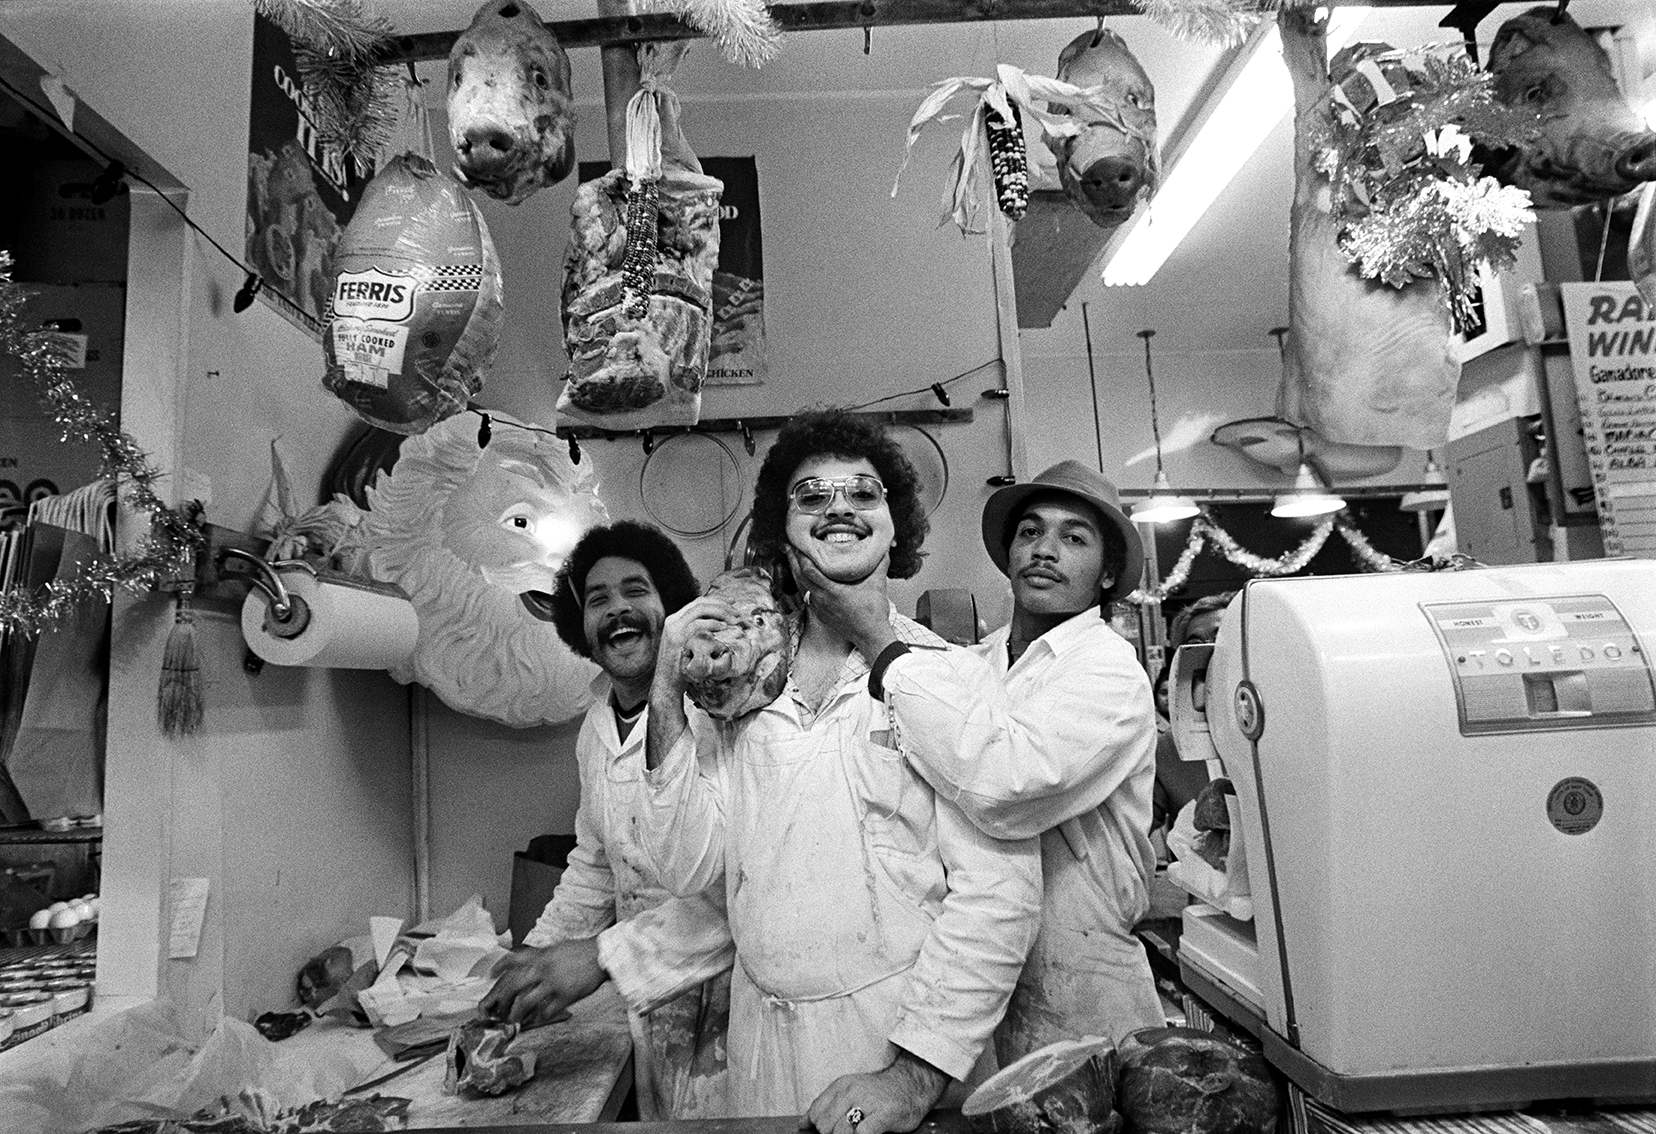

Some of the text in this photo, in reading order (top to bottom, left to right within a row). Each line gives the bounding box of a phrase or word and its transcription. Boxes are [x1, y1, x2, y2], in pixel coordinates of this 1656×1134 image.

[340, 282, 406, 303] FERRIS
[1588, 294, 1655, 326] RA
[346, 342, 386, 358] HAM
[361, 334, 395, 349] COOKED
[1589, 326, 1656, 357] WIN
[0, 457, 18, 468] EN
[1453, 612, 1605, 627] HONEST WEIGHT
[1468, 642, 1622, 669] TOLEDO
